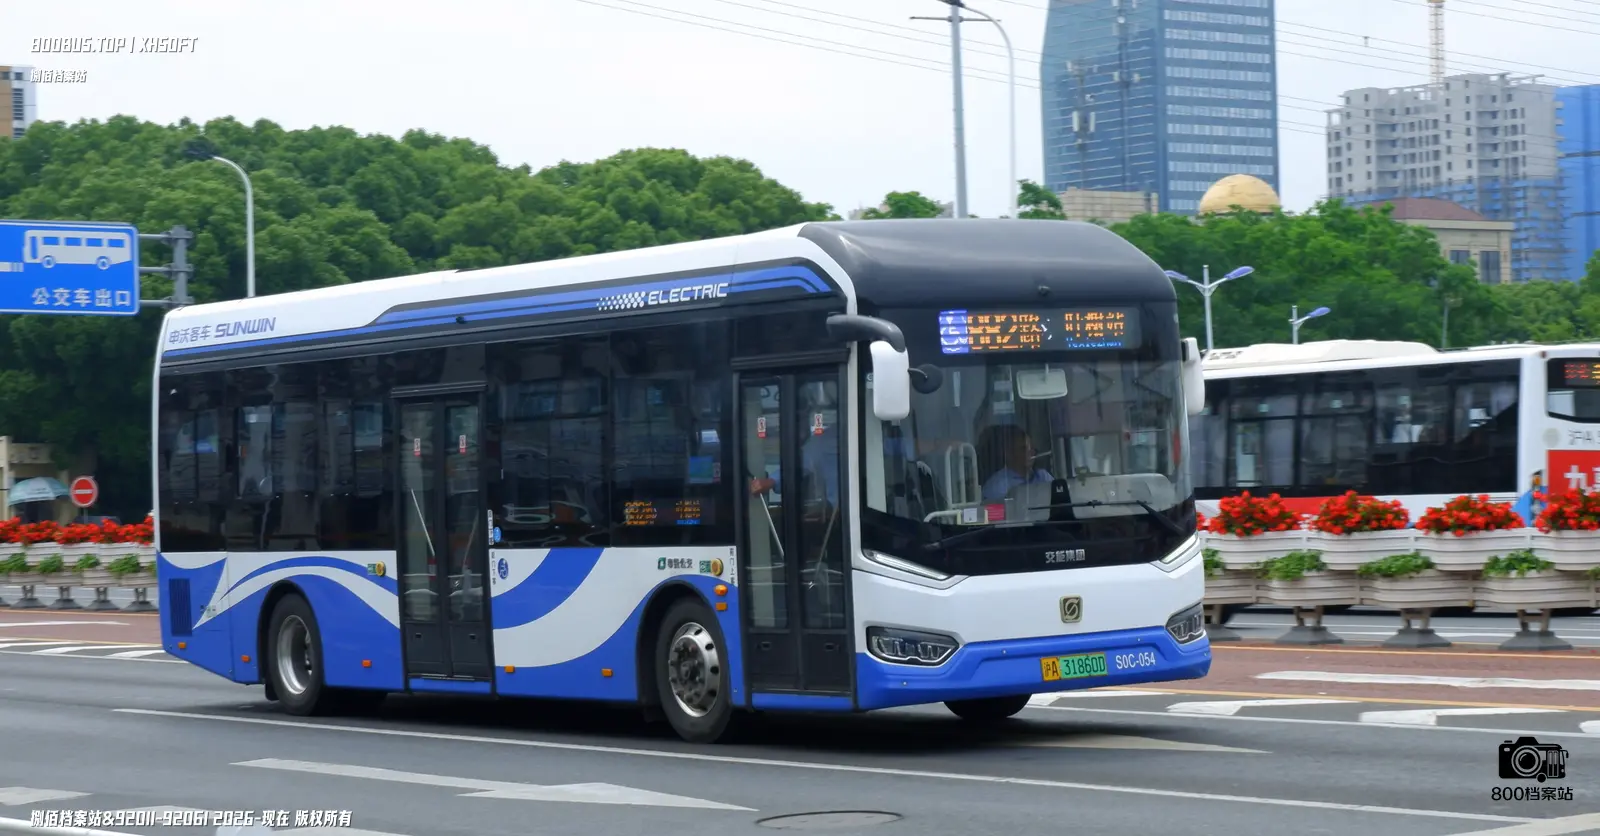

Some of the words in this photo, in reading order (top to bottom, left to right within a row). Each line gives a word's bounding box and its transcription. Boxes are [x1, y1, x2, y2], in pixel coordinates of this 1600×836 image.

[31, 286, 131, 308] 公交车出口
[647, 282, 729, 306] ELECTRIC
[168, 324, 211, 345] 申沃客车
[214, 316, 276, 339] SUNWIN
